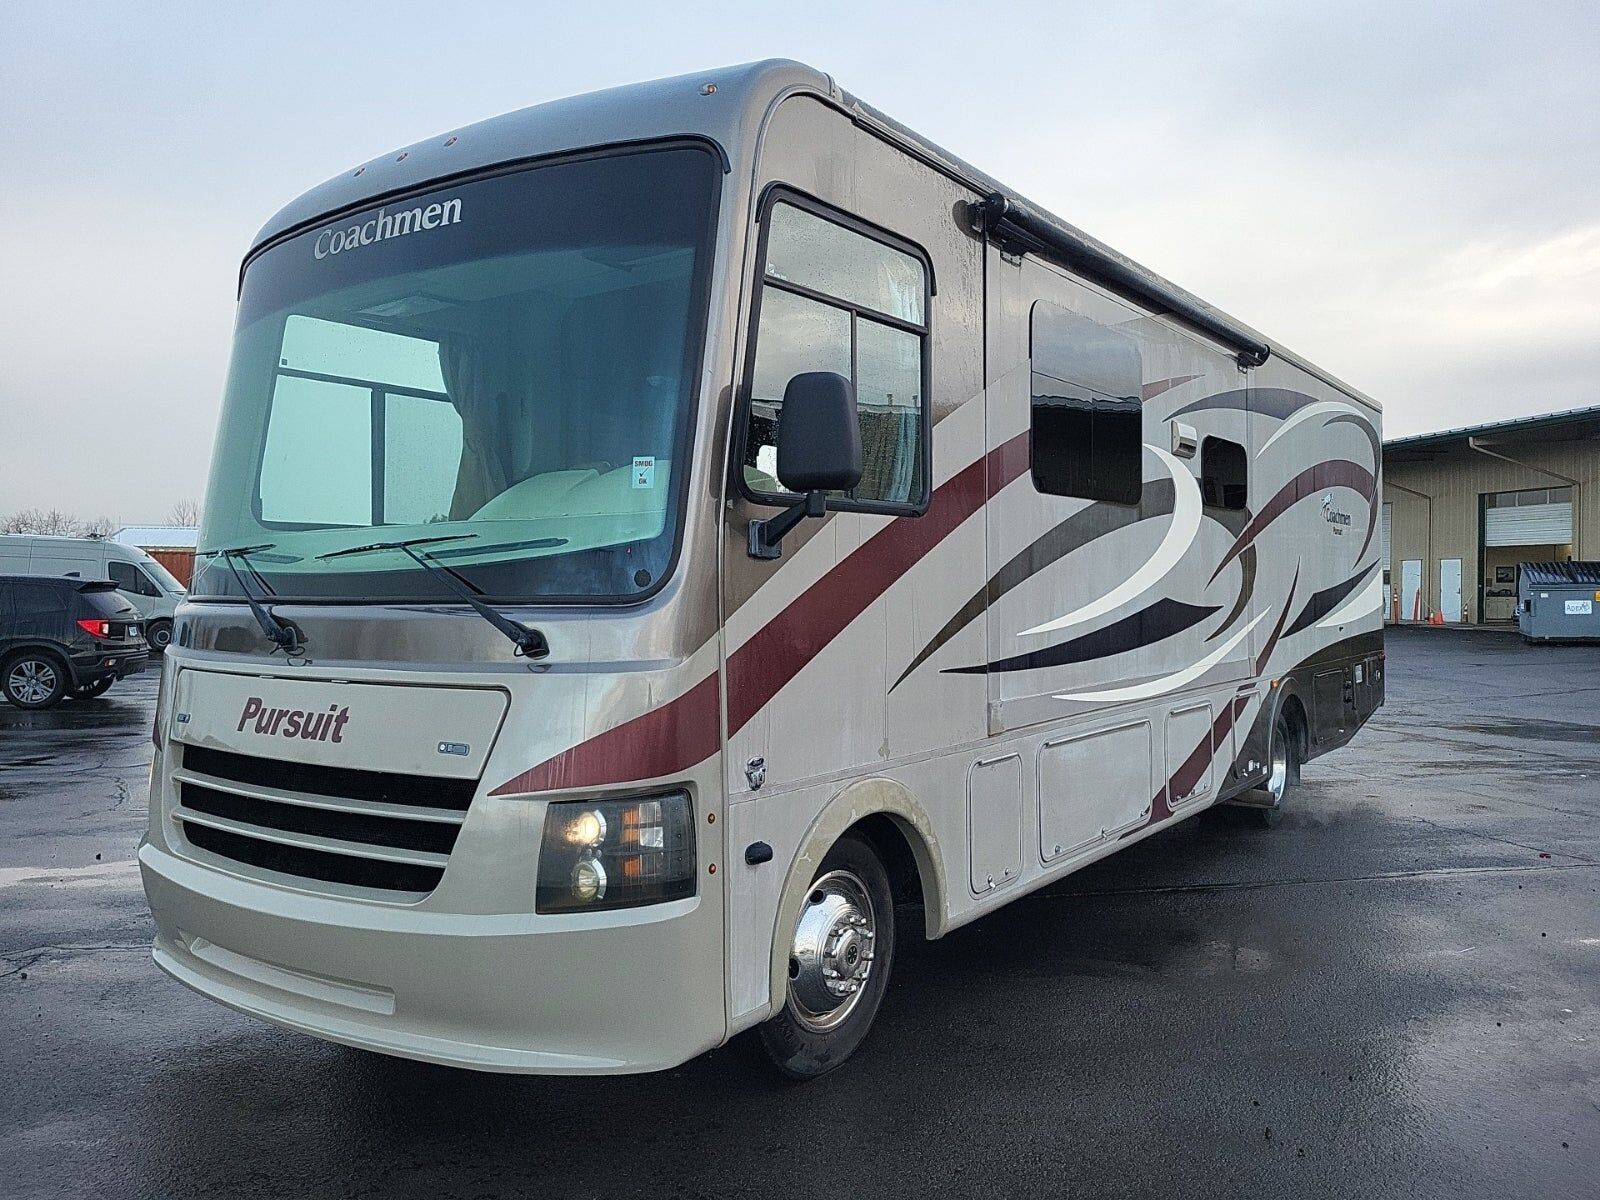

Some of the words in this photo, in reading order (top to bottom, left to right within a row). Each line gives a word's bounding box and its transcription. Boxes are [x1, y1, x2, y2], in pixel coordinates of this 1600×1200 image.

[315, 198, 462, 260] Coachmen
[1326, 507, 1351, 526] Coachmen
[237, 697, 349, 743] Pursuit
